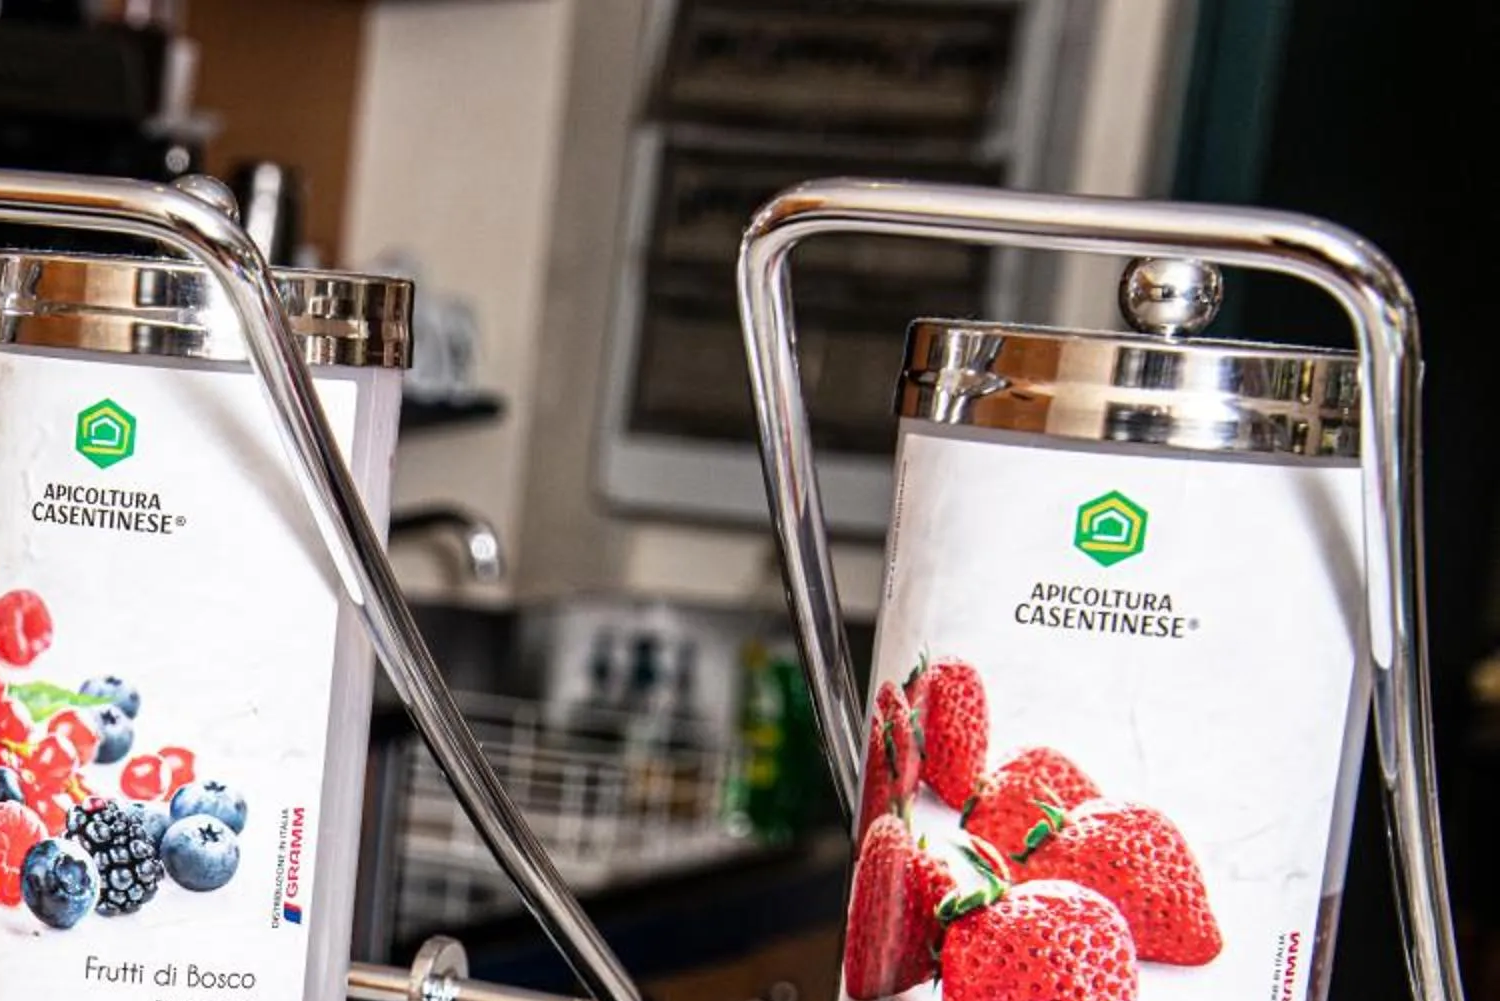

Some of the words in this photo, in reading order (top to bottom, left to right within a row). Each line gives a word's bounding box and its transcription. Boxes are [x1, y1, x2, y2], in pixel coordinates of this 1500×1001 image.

[44, 483, 161, 510] APICOLTURA
[1031, 582, 1173, 612] APICOLTURA
[285, 807, 305, 898] GRAMM
[85, 955, 144, 984] Frutti
[153, 963, 178, 987] di
[187, 963, 256, 989] Bosco
